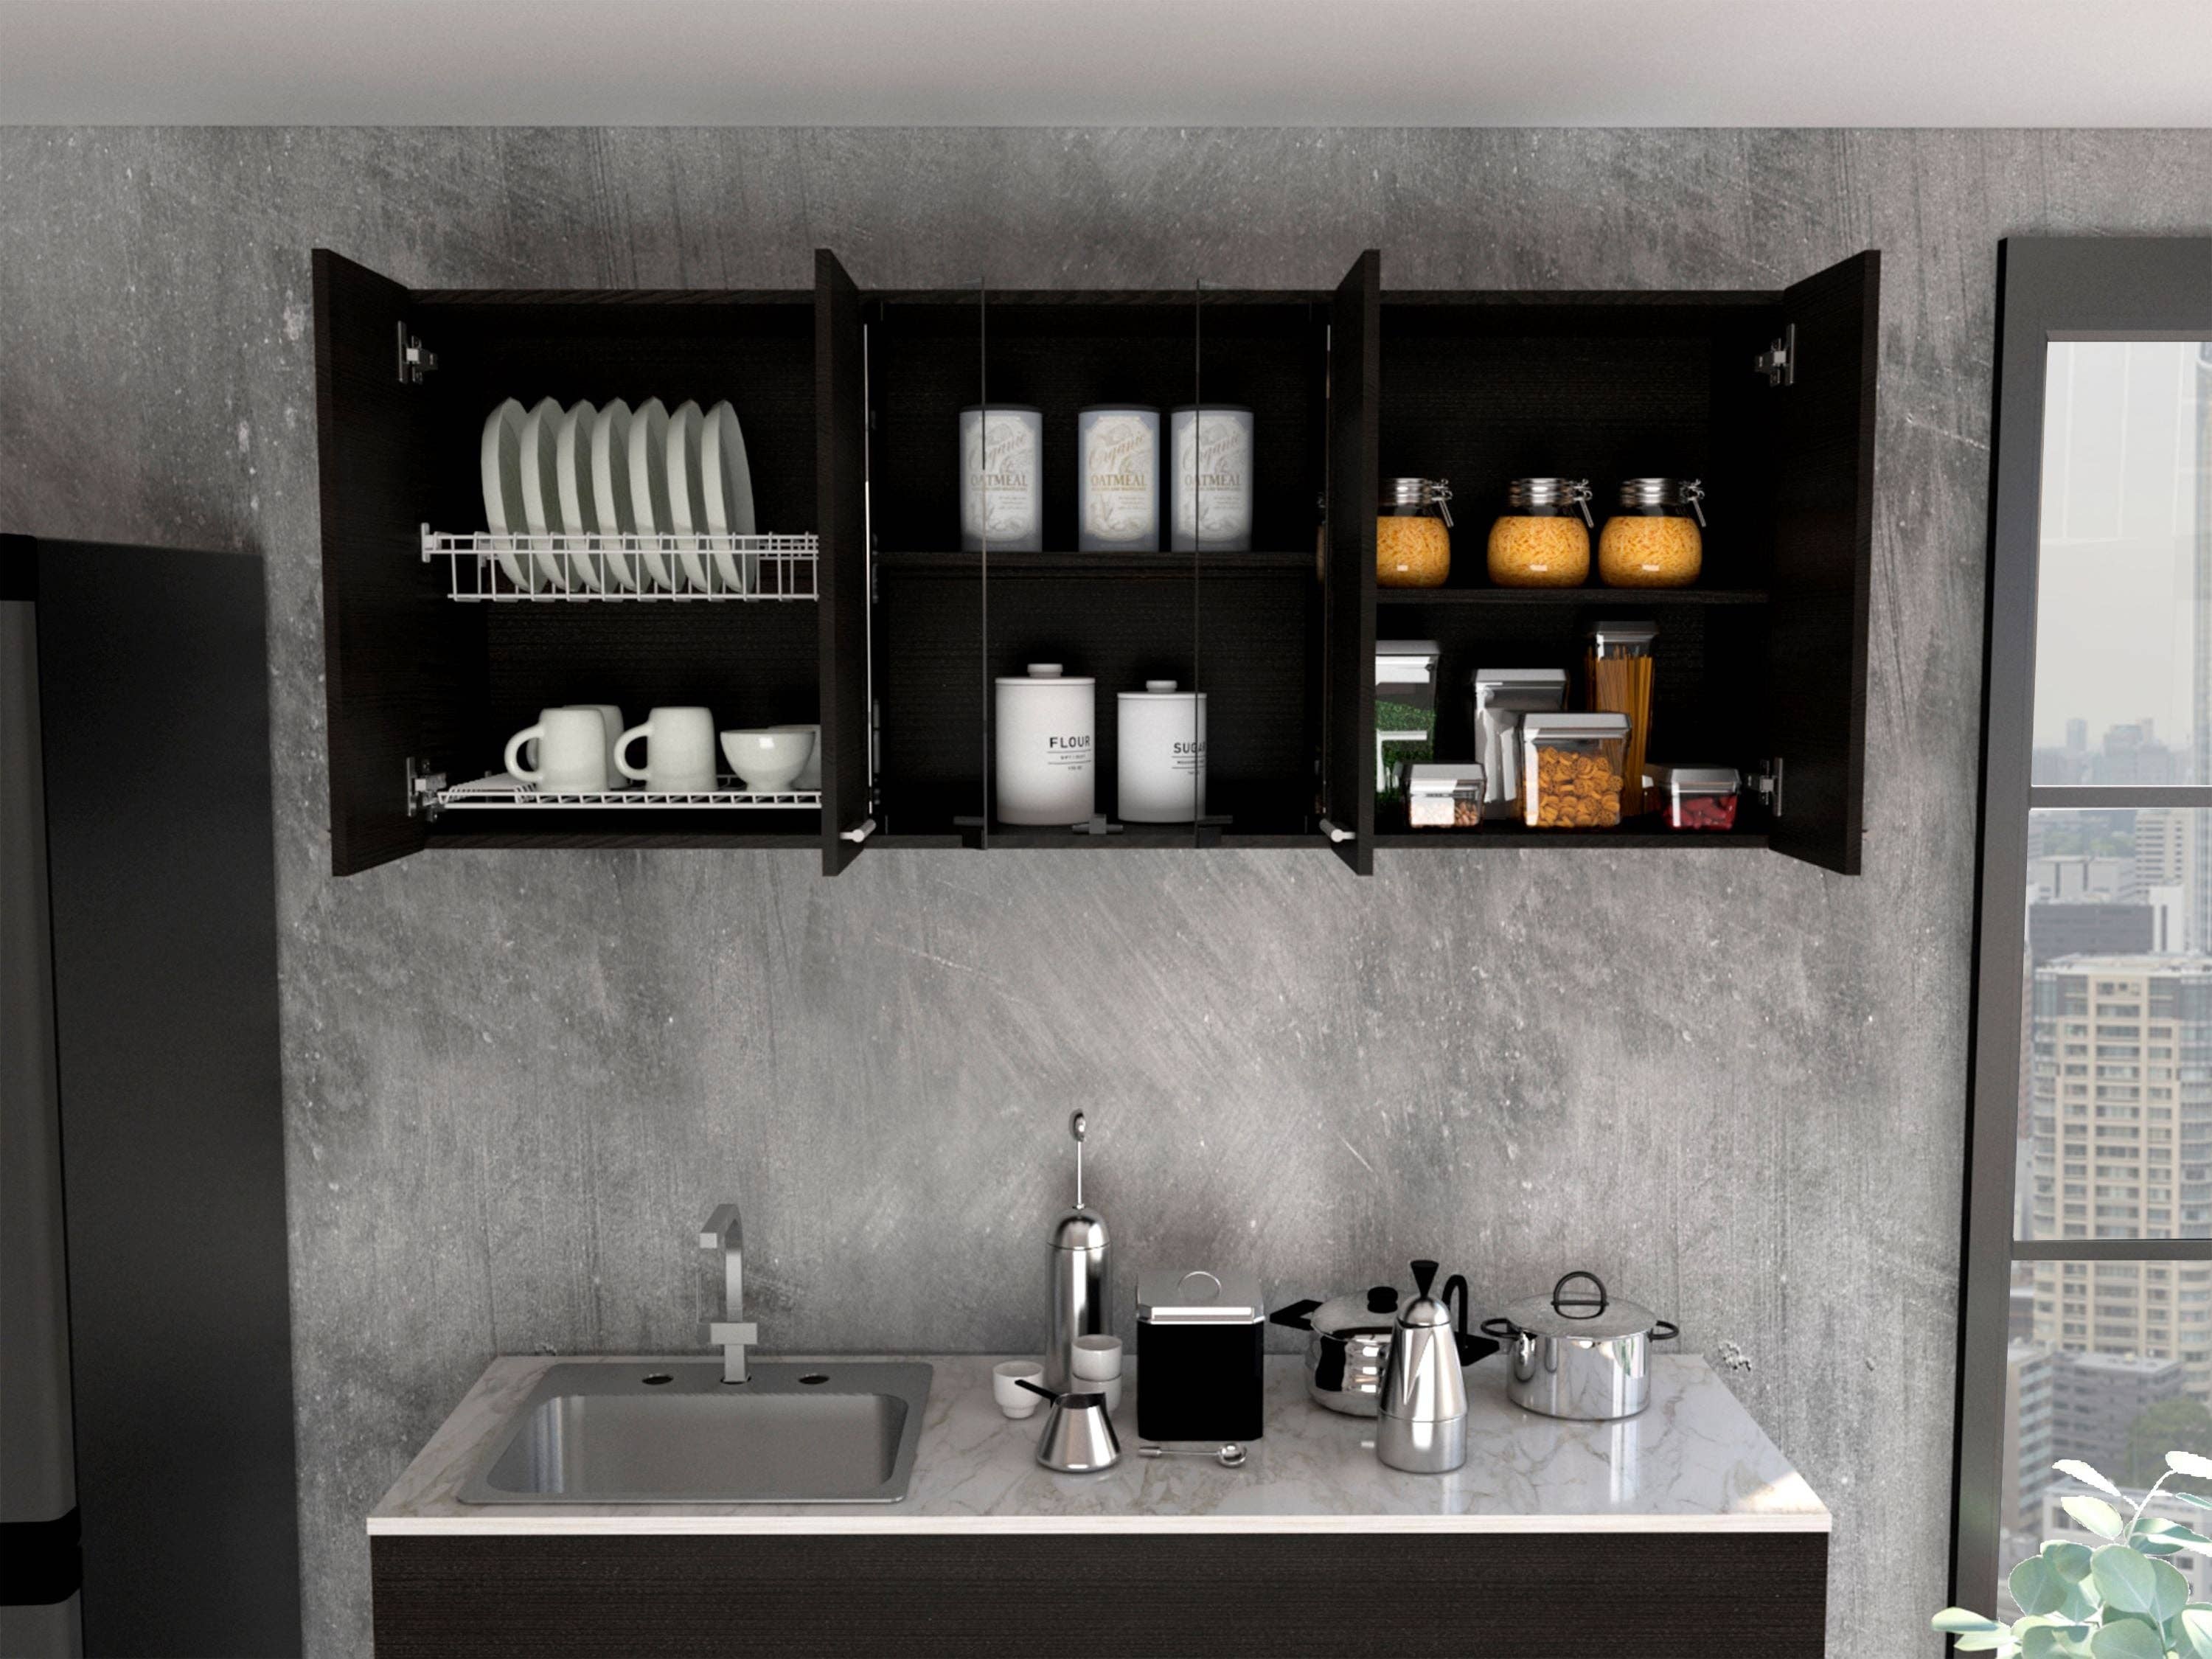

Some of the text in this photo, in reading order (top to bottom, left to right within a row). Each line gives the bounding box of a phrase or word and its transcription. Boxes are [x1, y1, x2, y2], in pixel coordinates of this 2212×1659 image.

[968, 431, 1026, 472] Oganic
[1088, 431, 1145, 472] Organic
[1091, 474, 1147, 486] OATMEAL
[1185, 474, 1241, 486] OTMEAL
[1050, 736, 1090, 748] FLOUR
